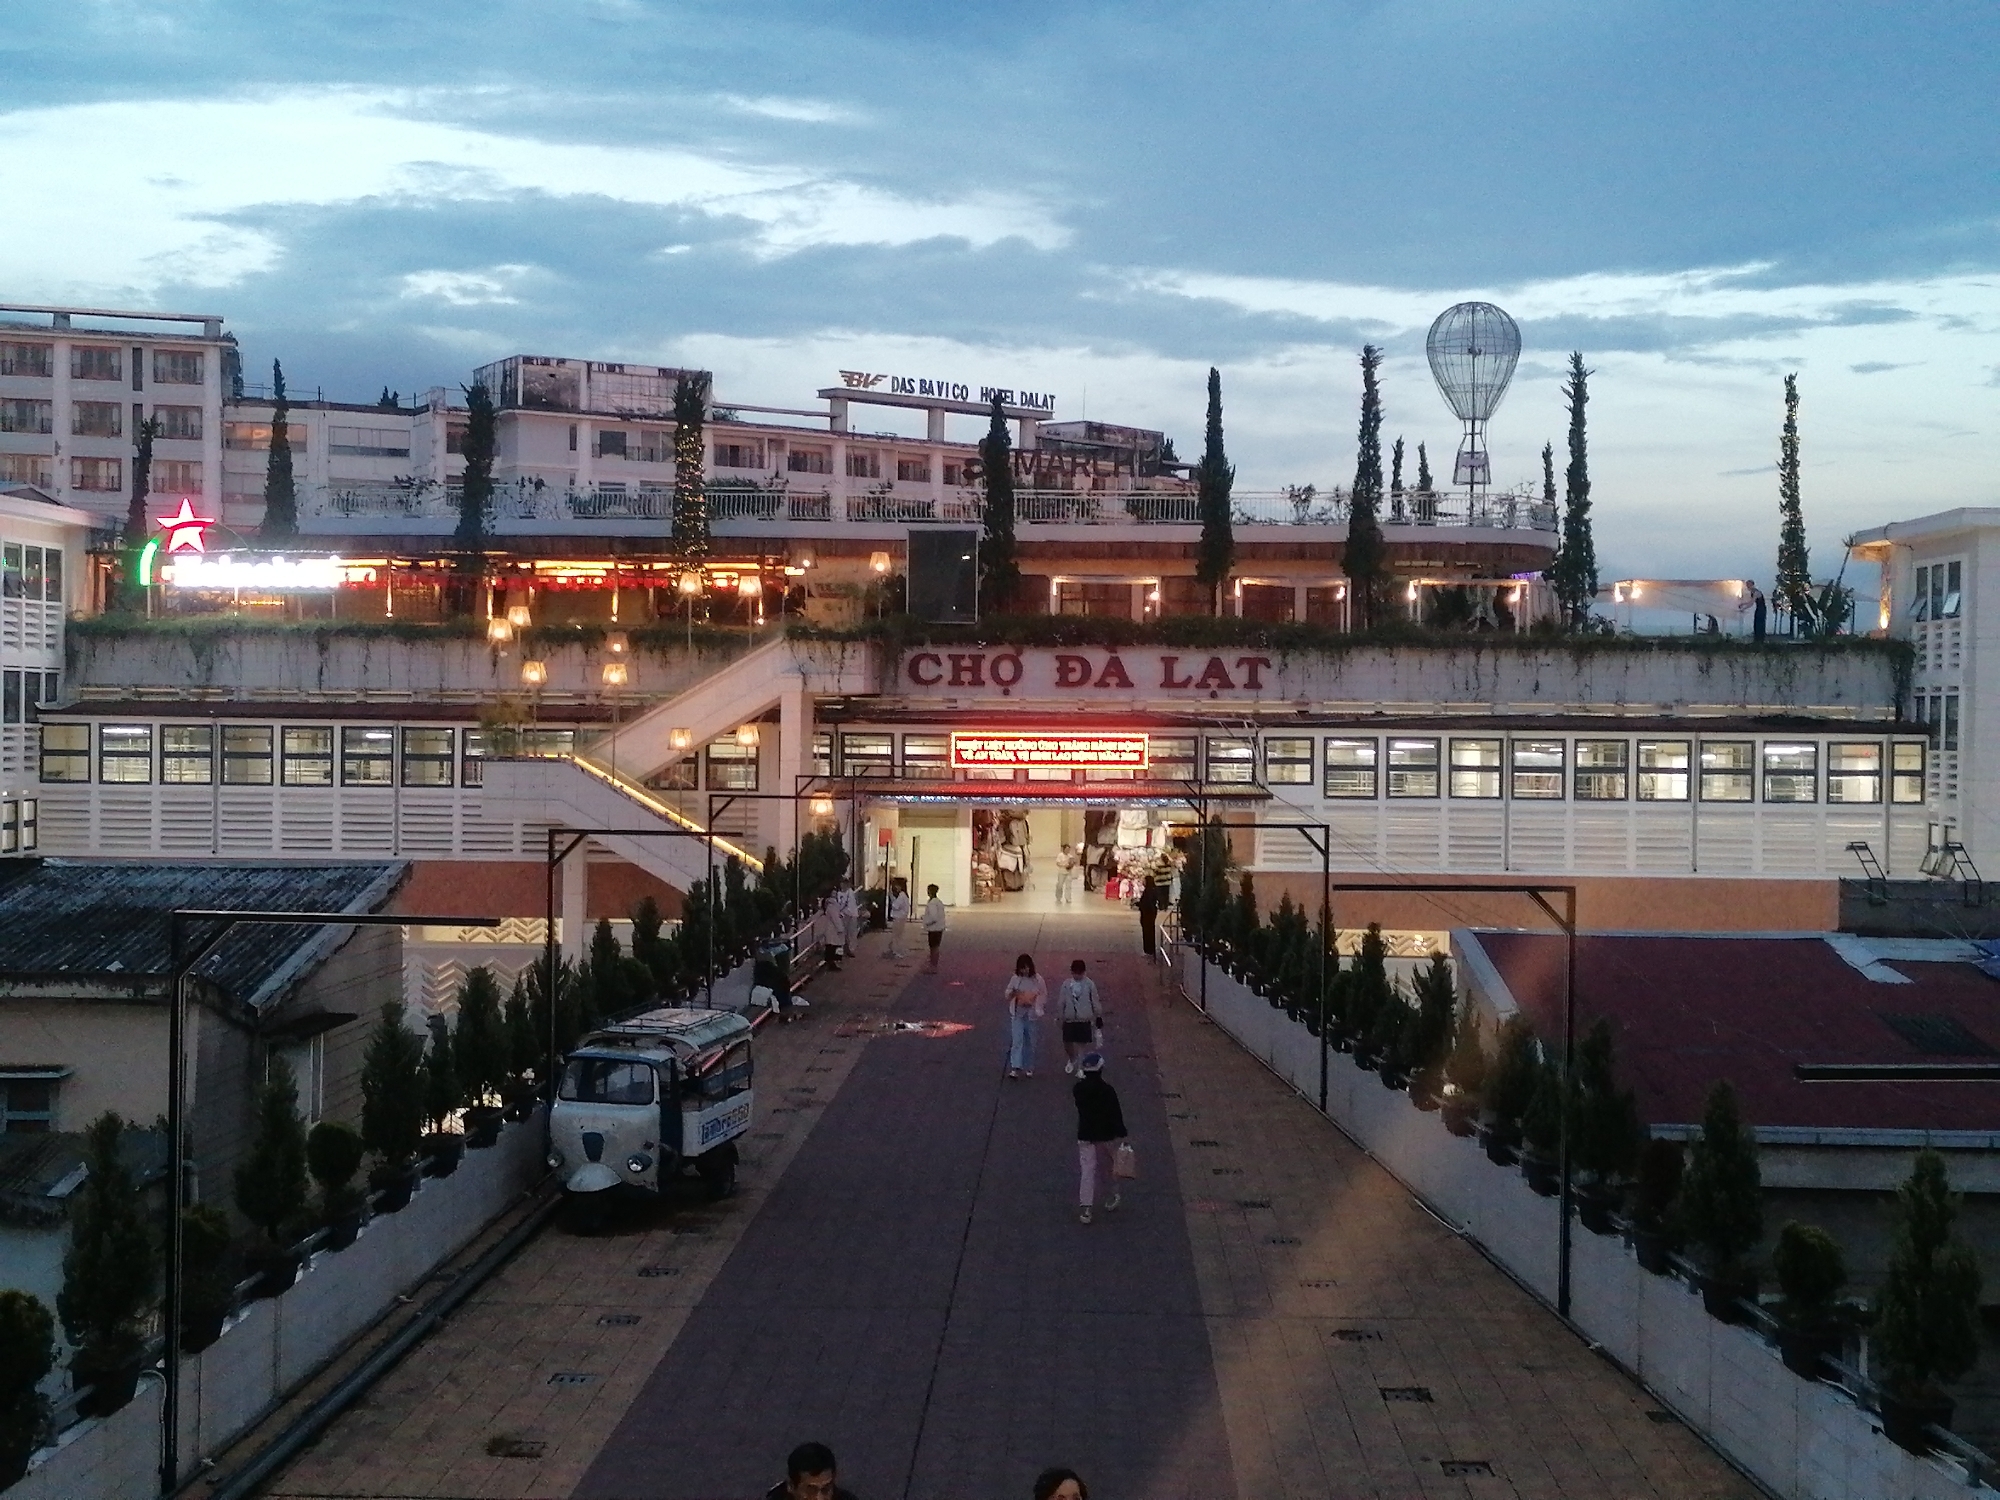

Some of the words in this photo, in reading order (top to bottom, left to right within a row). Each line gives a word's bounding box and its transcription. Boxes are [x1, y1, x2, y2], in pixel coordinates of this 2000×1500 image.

[891, 376, 916, 394] DAS
[1020, 391, 1055, 410] DALAT
[908, 648, 1023, 695] CHỢ
[1055, 646, 1134, 688] ĐÀ
[1159, 656, 1271, 697] LẠT
